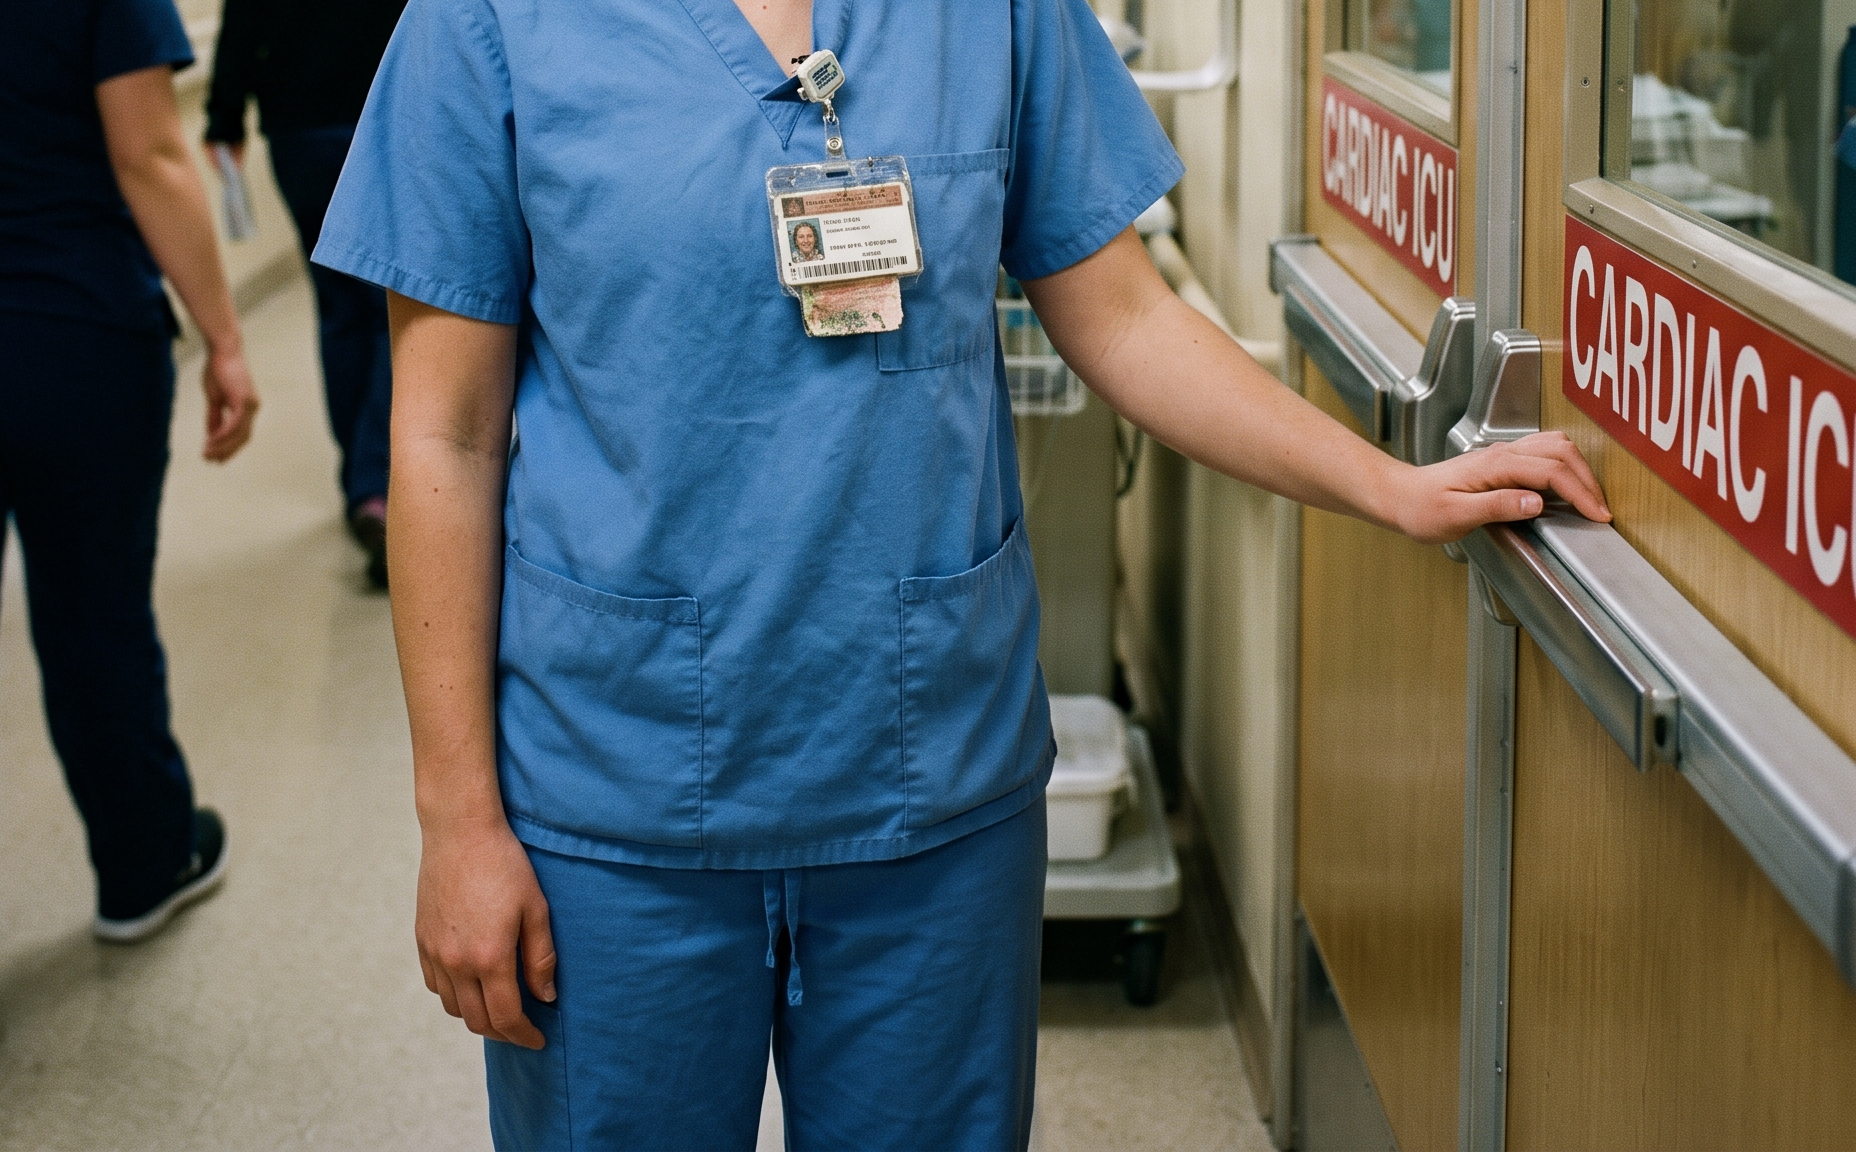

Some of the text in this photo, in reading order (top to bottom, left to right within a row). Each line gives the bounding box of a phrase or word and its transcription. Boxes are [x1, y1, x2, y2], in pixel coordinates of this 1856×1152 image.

[1323, 94, 1454, 283] CARDIAC ICU
[1570, 245, 1856, 599] CARDIAC IC
